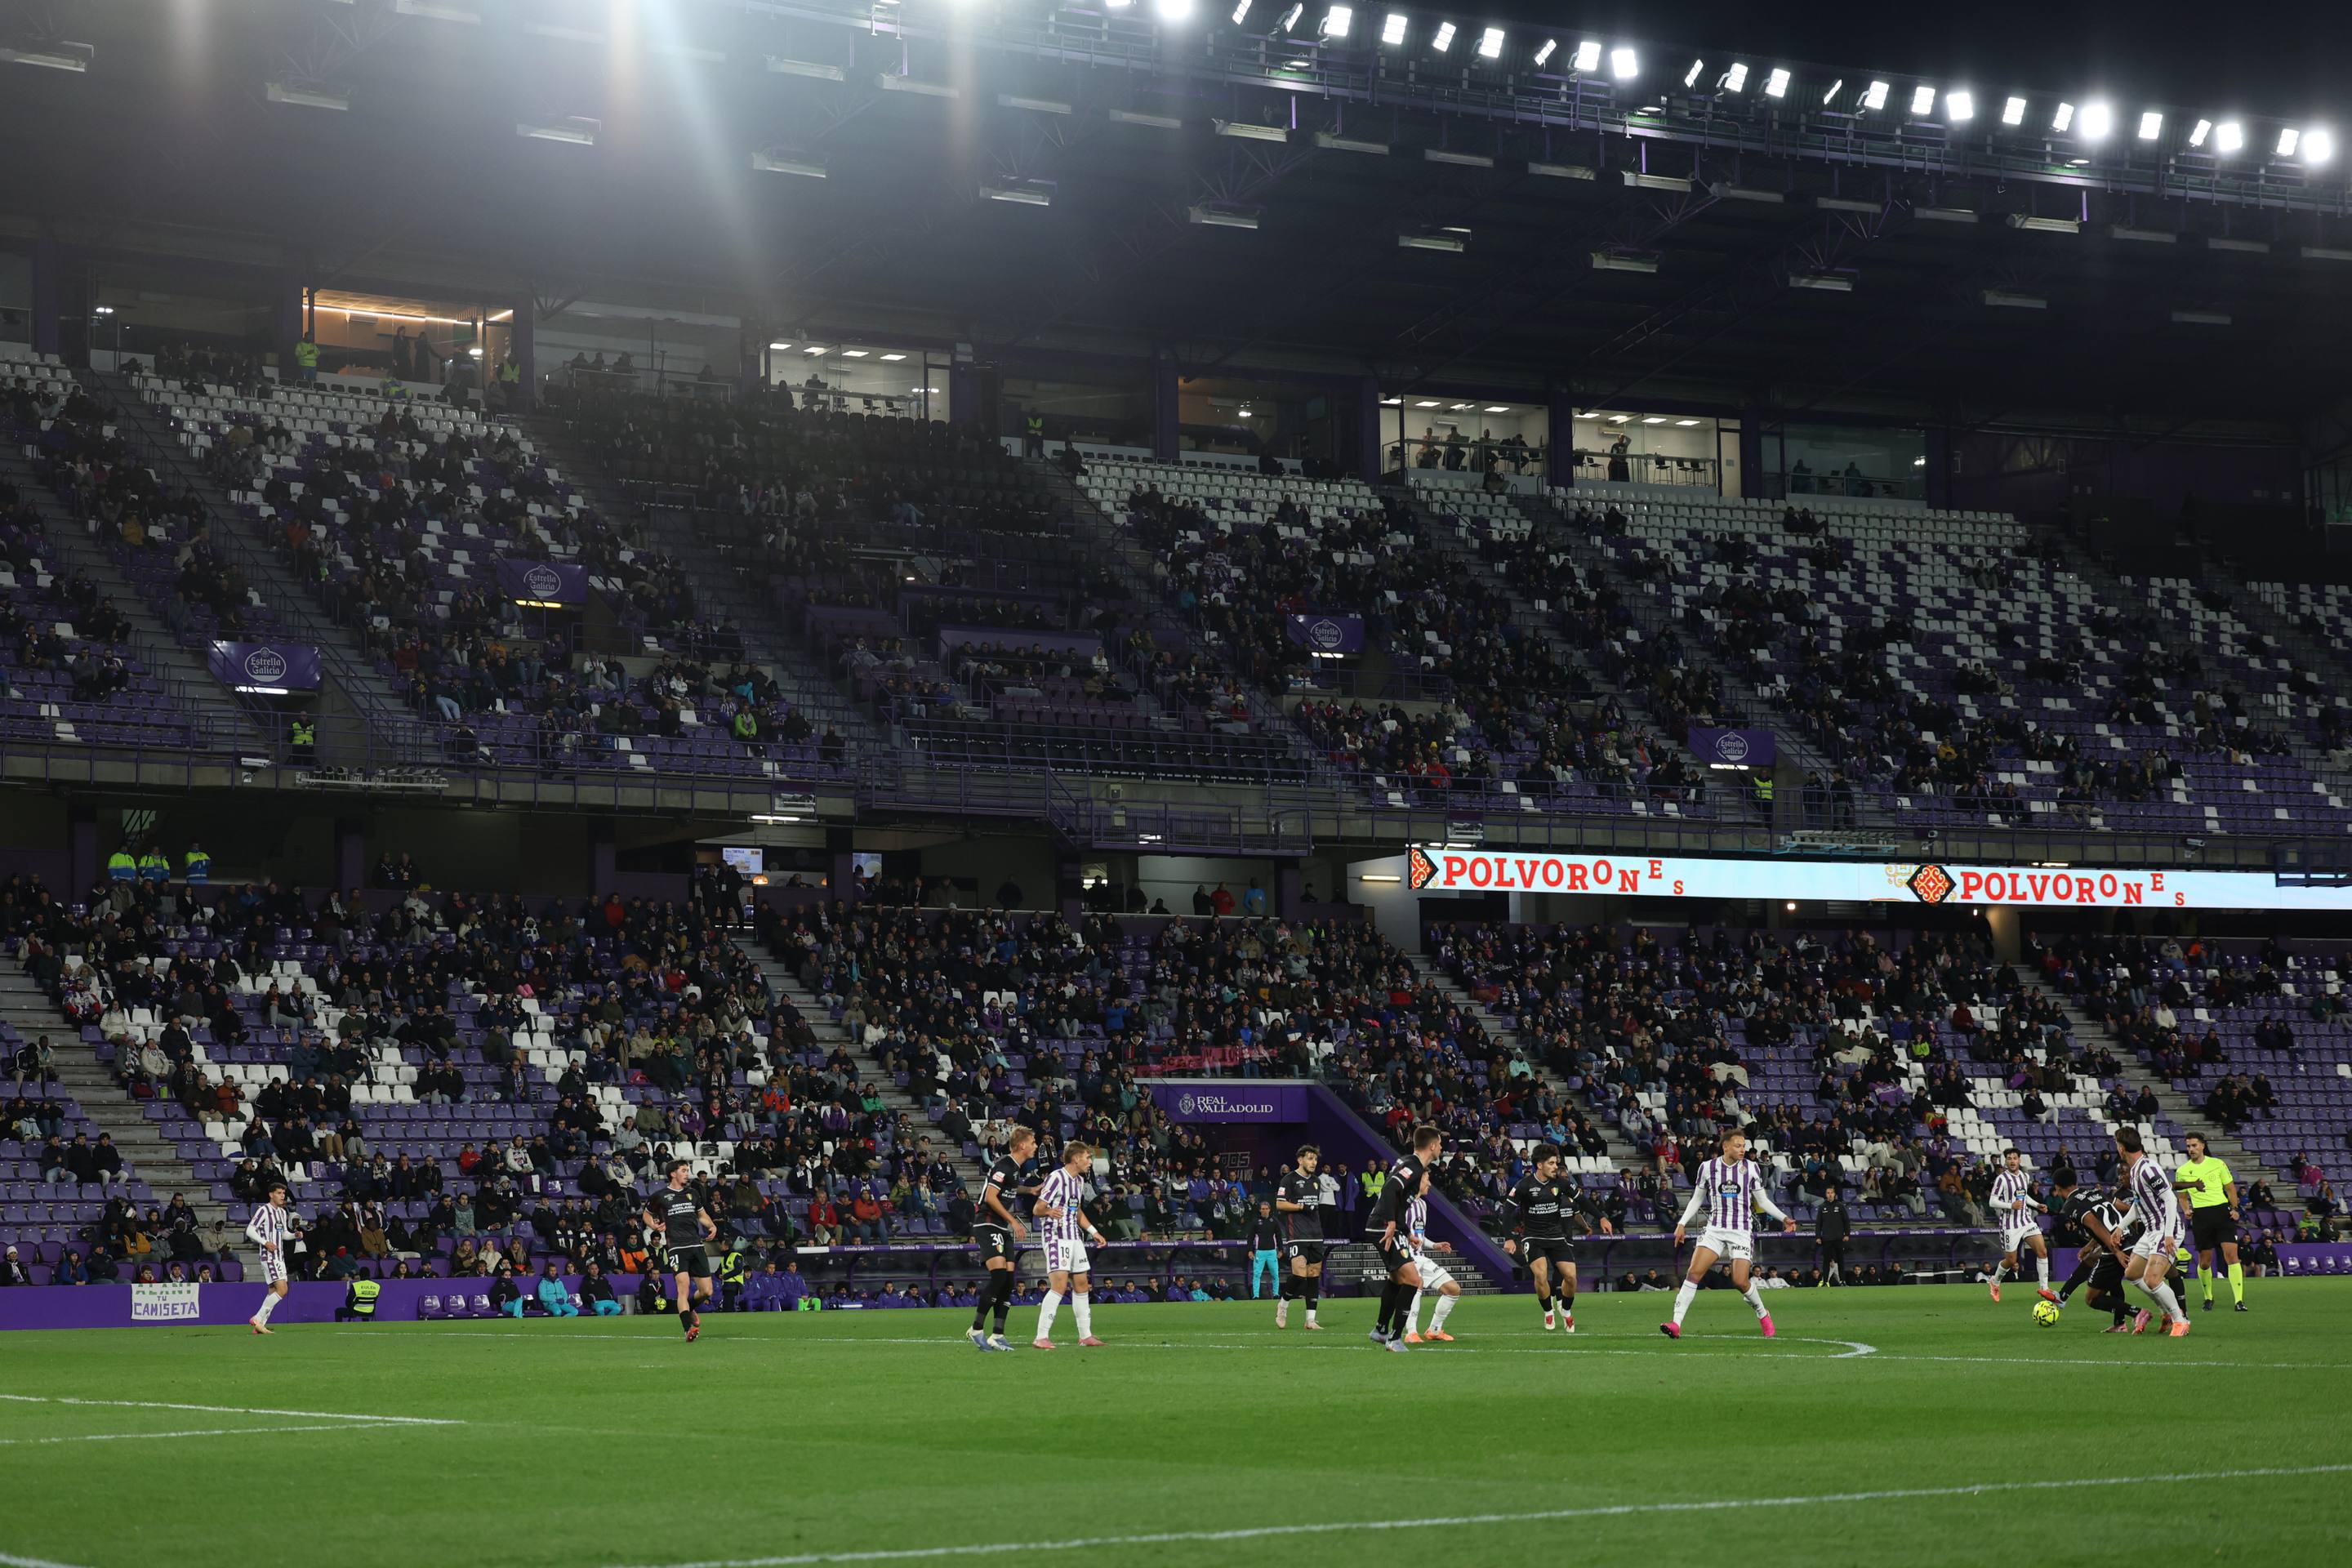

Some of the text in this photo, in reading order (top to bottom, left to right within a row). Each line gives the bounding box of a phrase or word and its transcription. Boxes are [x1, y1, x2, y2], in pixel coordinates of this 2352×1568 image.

[529, 573, 556, 582] Estrella
[530, 581, 555, 590] Galicia
[1315, 627, 1339, 635] Estrella
[1316, 635, 1338, 643] Galicia
[251, 657, 281, 666] Estrella
[252, 666, 280, 675] Galicia
[1721, 739, 1744, 747] Estrella
[1722, 746, 1744, 755] Galicia
[1196, 1096, 1228, 1105] REAL
[1197, 1104, 1274, 1113] VALLADOLID
[2151, 1178, 2163, 1188] DIGI
[991, 1233, 1004, 1246] 30
[1061, 1246, 1070, 1258] 19
[670, 1254, 679, 1267] 21
[134, 1302, 198, 1316] CAMISETA
